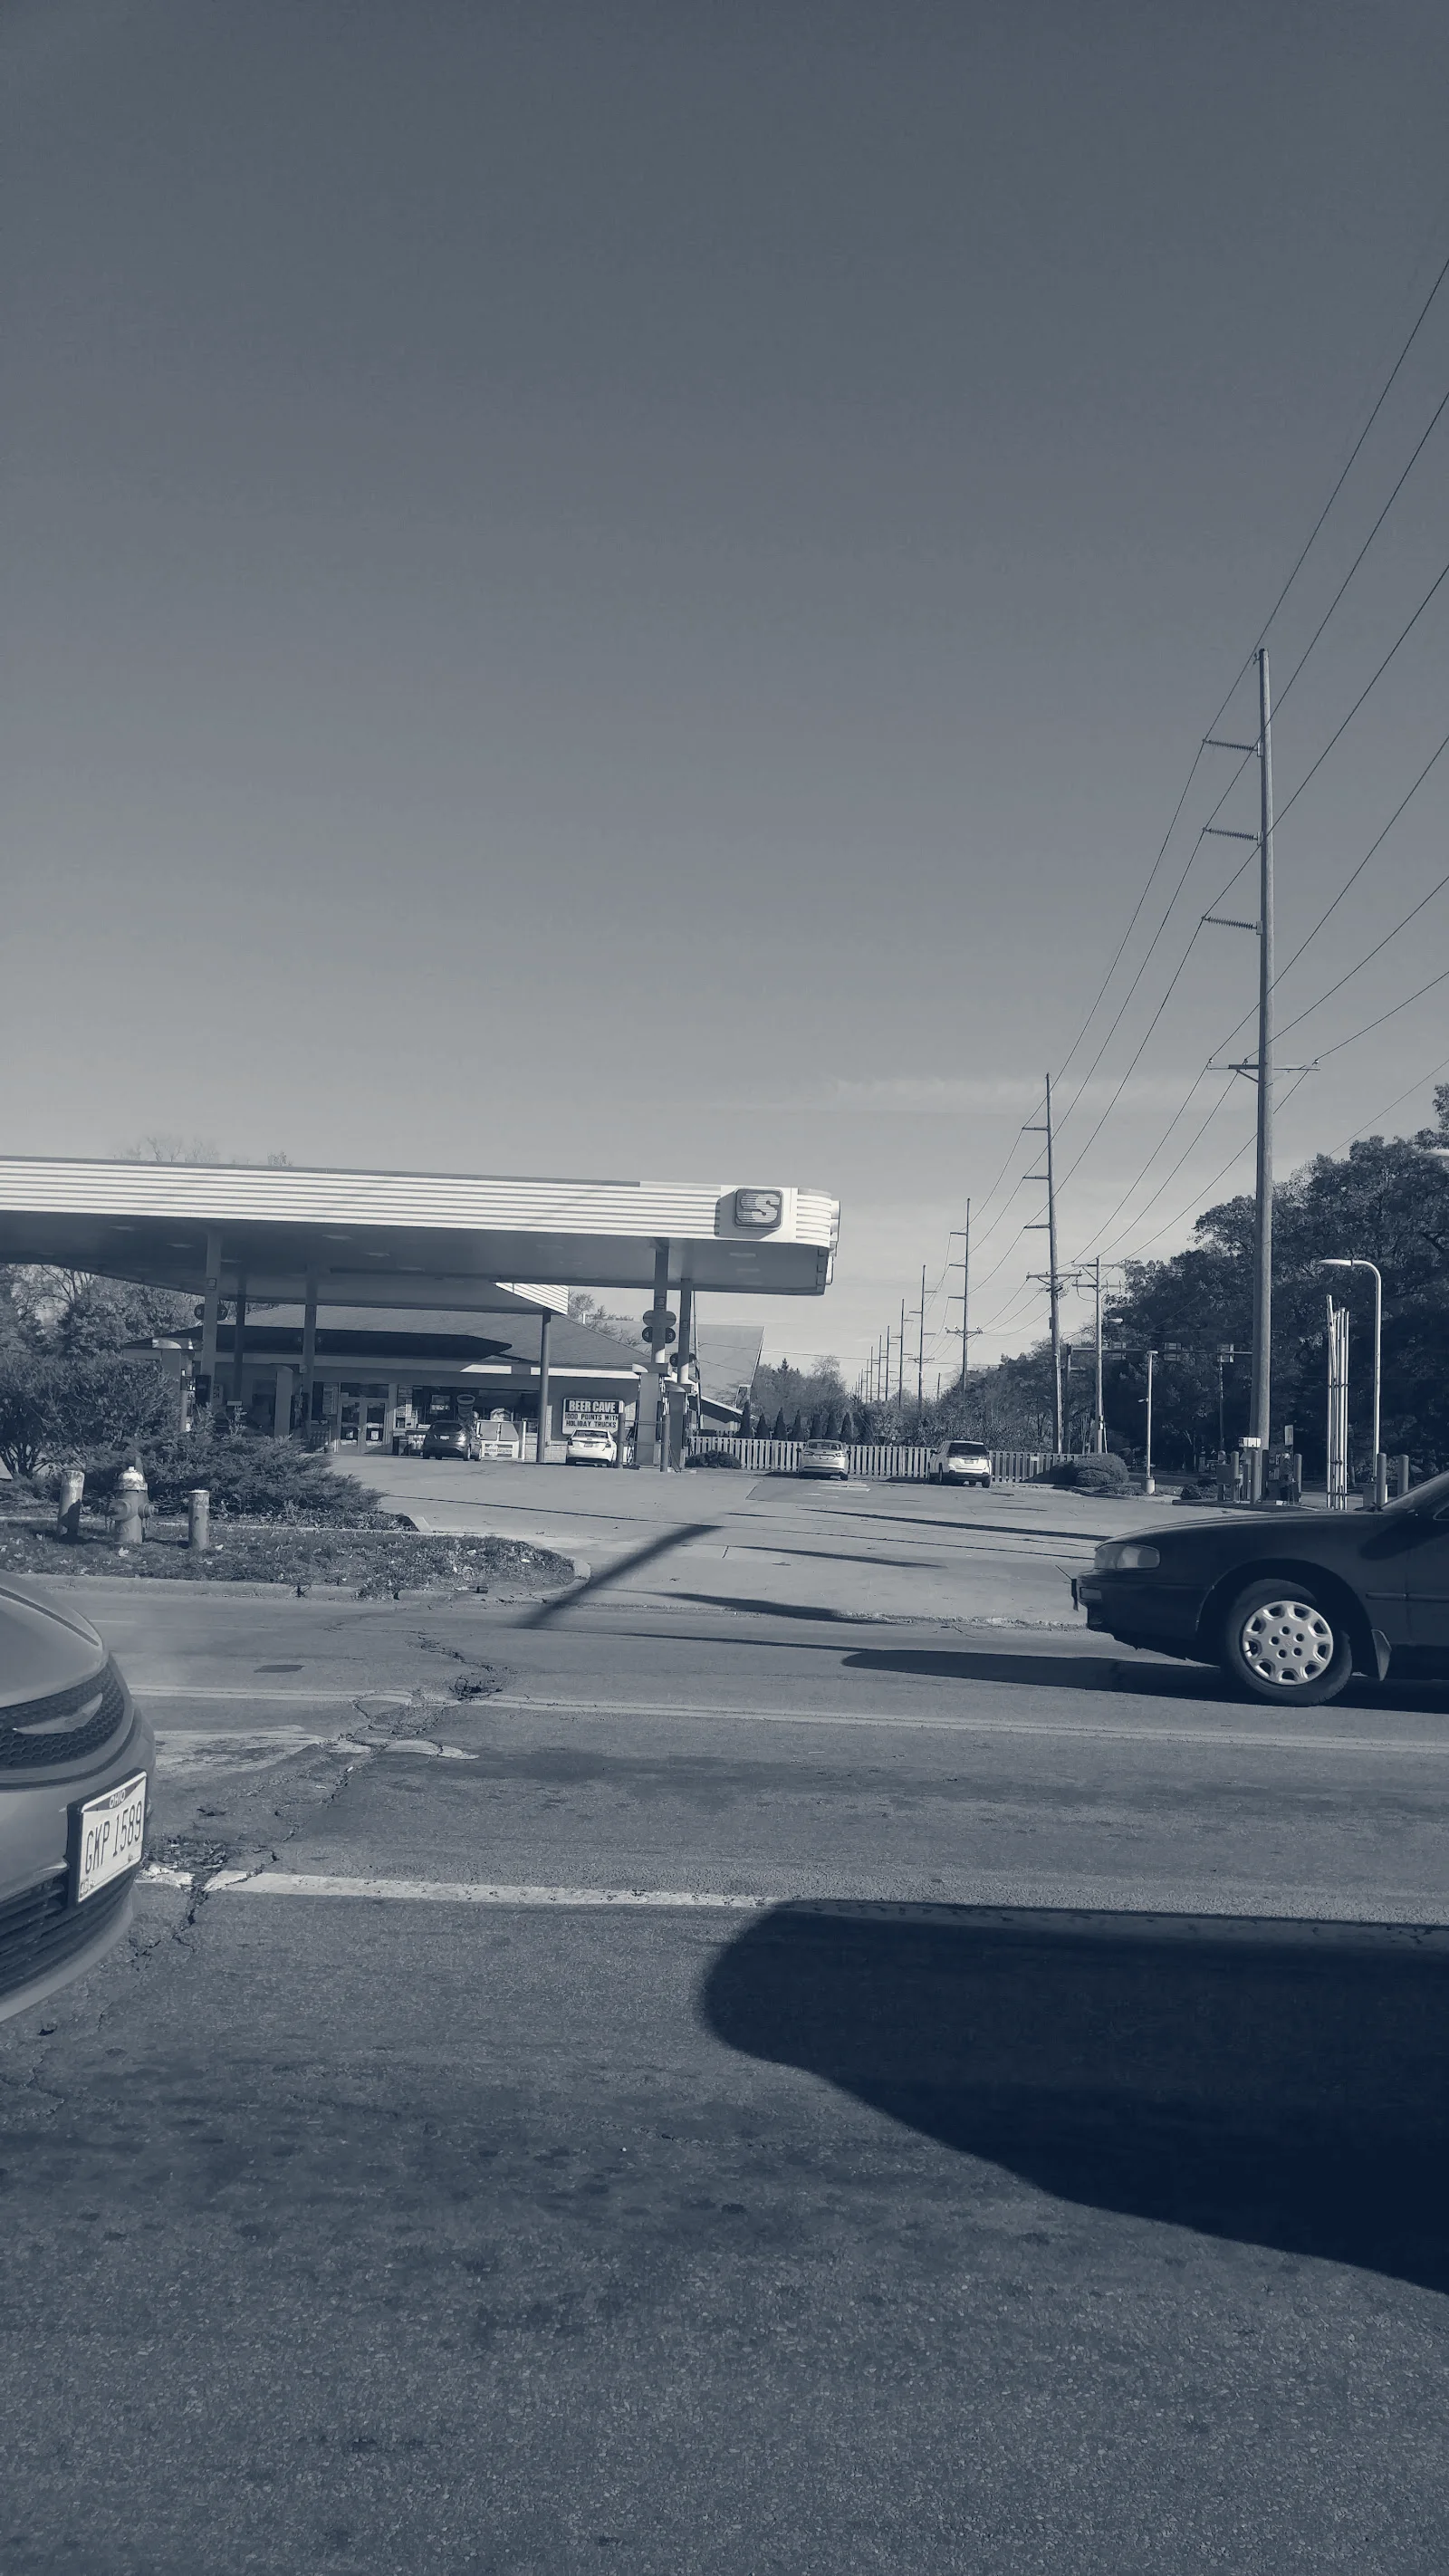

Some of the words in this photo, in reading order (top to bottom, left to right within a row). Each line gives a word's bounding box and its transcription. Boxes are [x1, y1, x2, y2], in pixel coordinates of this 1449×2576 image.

[569, 1400, 591, 1413] BEER
[592, 1400, 616, 1413] CAVE
[109, 1789, 126, 1809] OHIO
[85, 1820, 110, 1875] GKP
[112, 1800, 142, 1858] 1589
